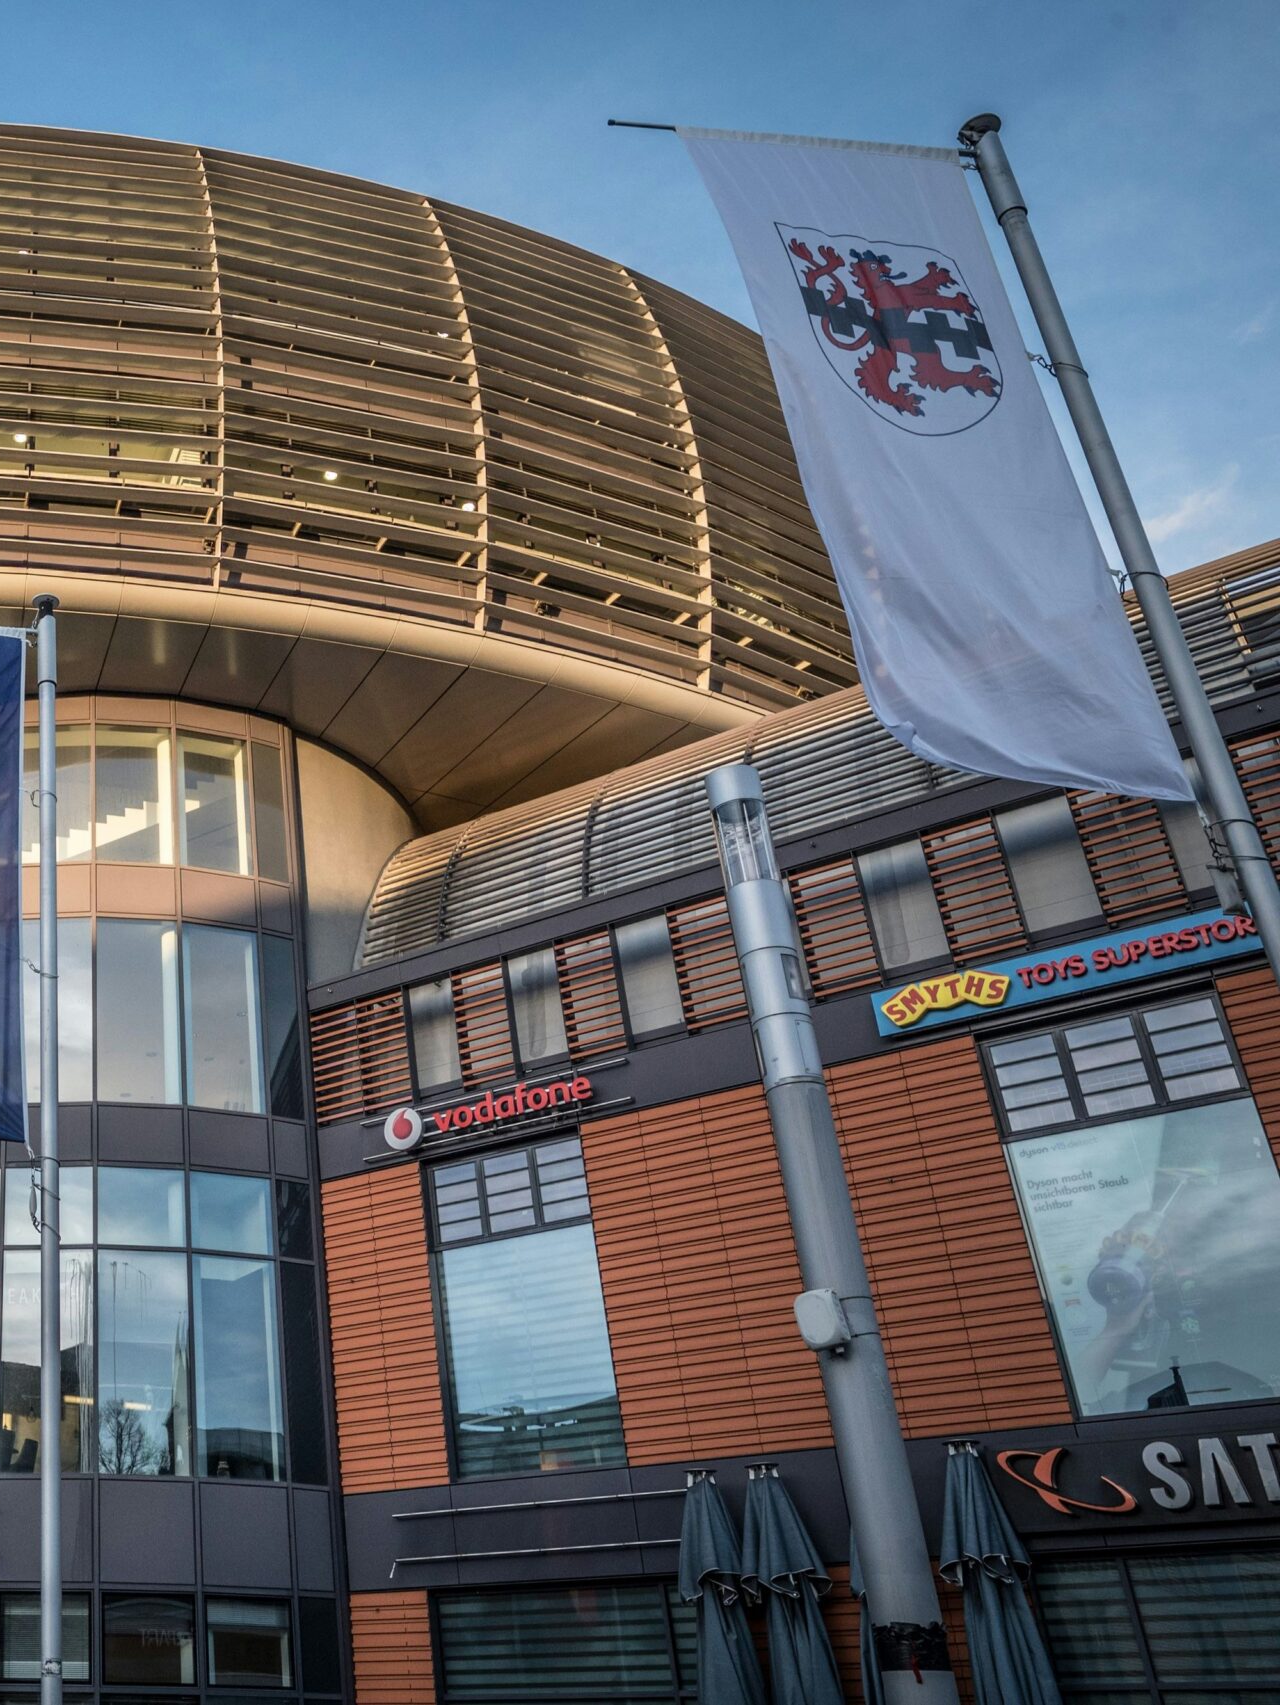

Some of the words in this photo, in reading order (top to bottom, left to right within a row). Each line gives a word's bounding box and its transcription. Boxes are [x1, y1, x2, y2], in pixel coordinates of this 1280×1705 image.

[885, 978, 1005, 1022] SMYTHS
[1017, 955, 1087, 988] TOYS
[432, 1076, 593, 1133] vodafone
[1026, 1177, 1059, 1190] Dyson
[1061, 1169, 1093, 1184] macht
[1029, 1183, 1096, 1200] unsichtbaren
[1098, 1175, 1129, 1190] Staub
[1033, 1200, 1073, 1213] sichtbar
[1142, 1432, 1280, 1509] SAT
